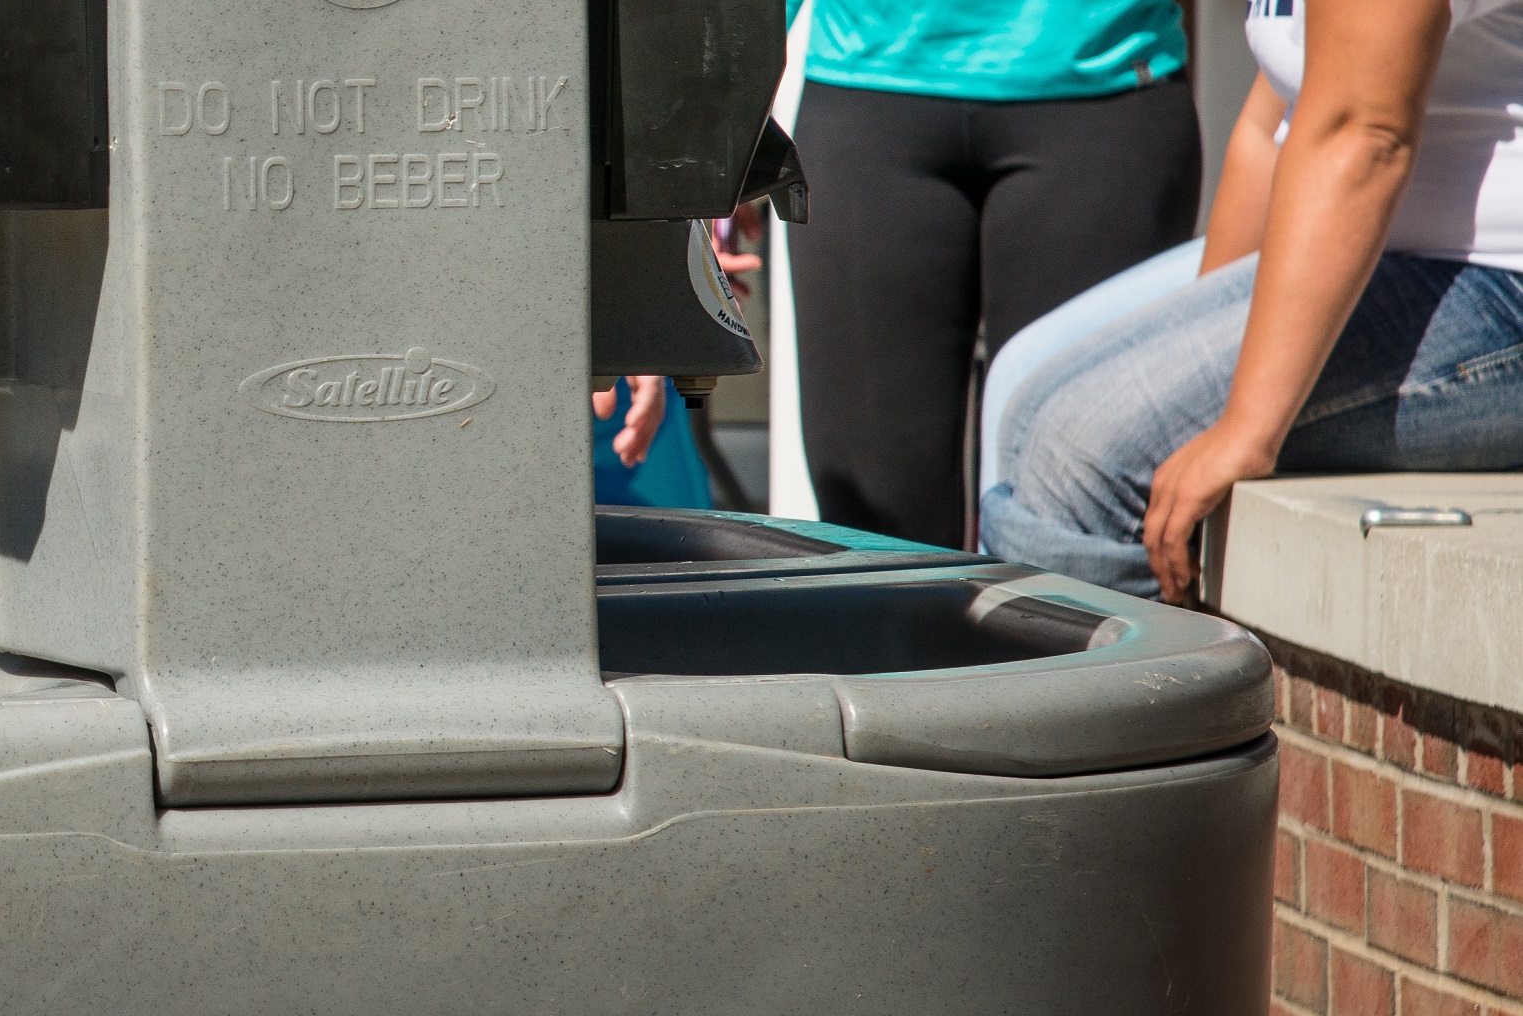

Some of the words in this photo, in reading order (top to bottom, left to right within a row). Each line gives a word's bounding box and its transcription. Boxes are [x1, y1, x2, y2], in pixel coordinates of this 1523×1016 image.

[158, 81, 232, 136] DO
[270, 79, 376, 135] NOT
[417, 76, 570, 134] DRINK
[223, 156, 295, 211] NO
[333, 153, 505, 210] BEBER
[281, 347, 455, 408] Satellite
